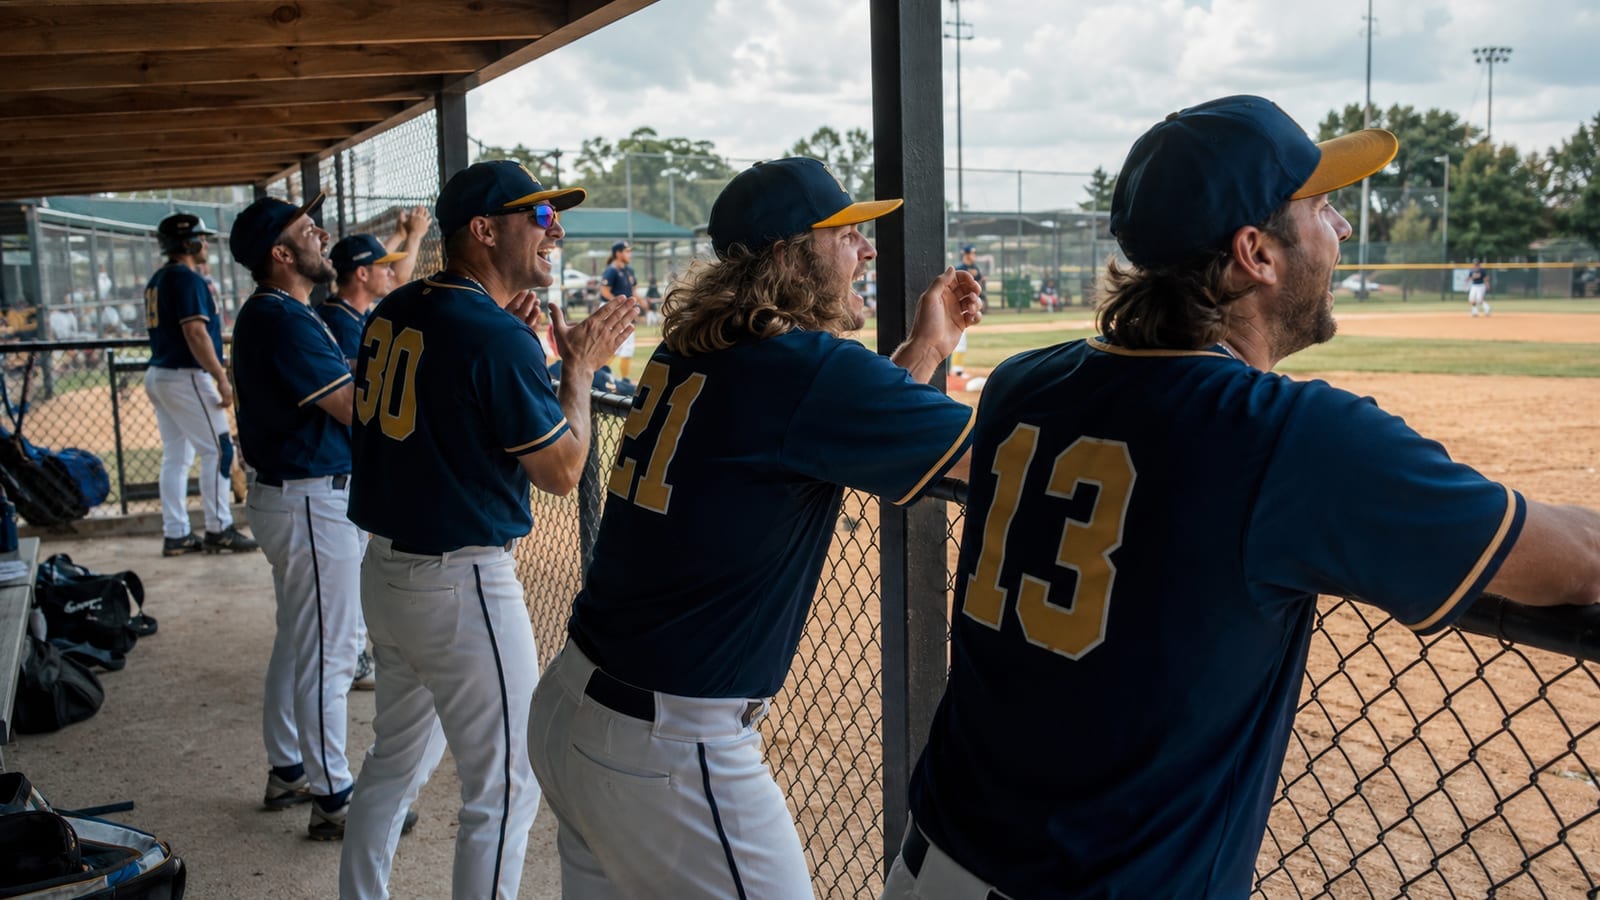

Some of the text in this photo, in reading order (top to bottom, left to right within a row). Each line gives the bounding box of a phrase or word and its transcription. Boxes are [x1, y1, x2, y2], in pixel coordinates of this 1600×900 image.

[354, 317, 424, 441] 30
[608, 360, 707, 515] 21
[962, 422, 1137, 661] 13
